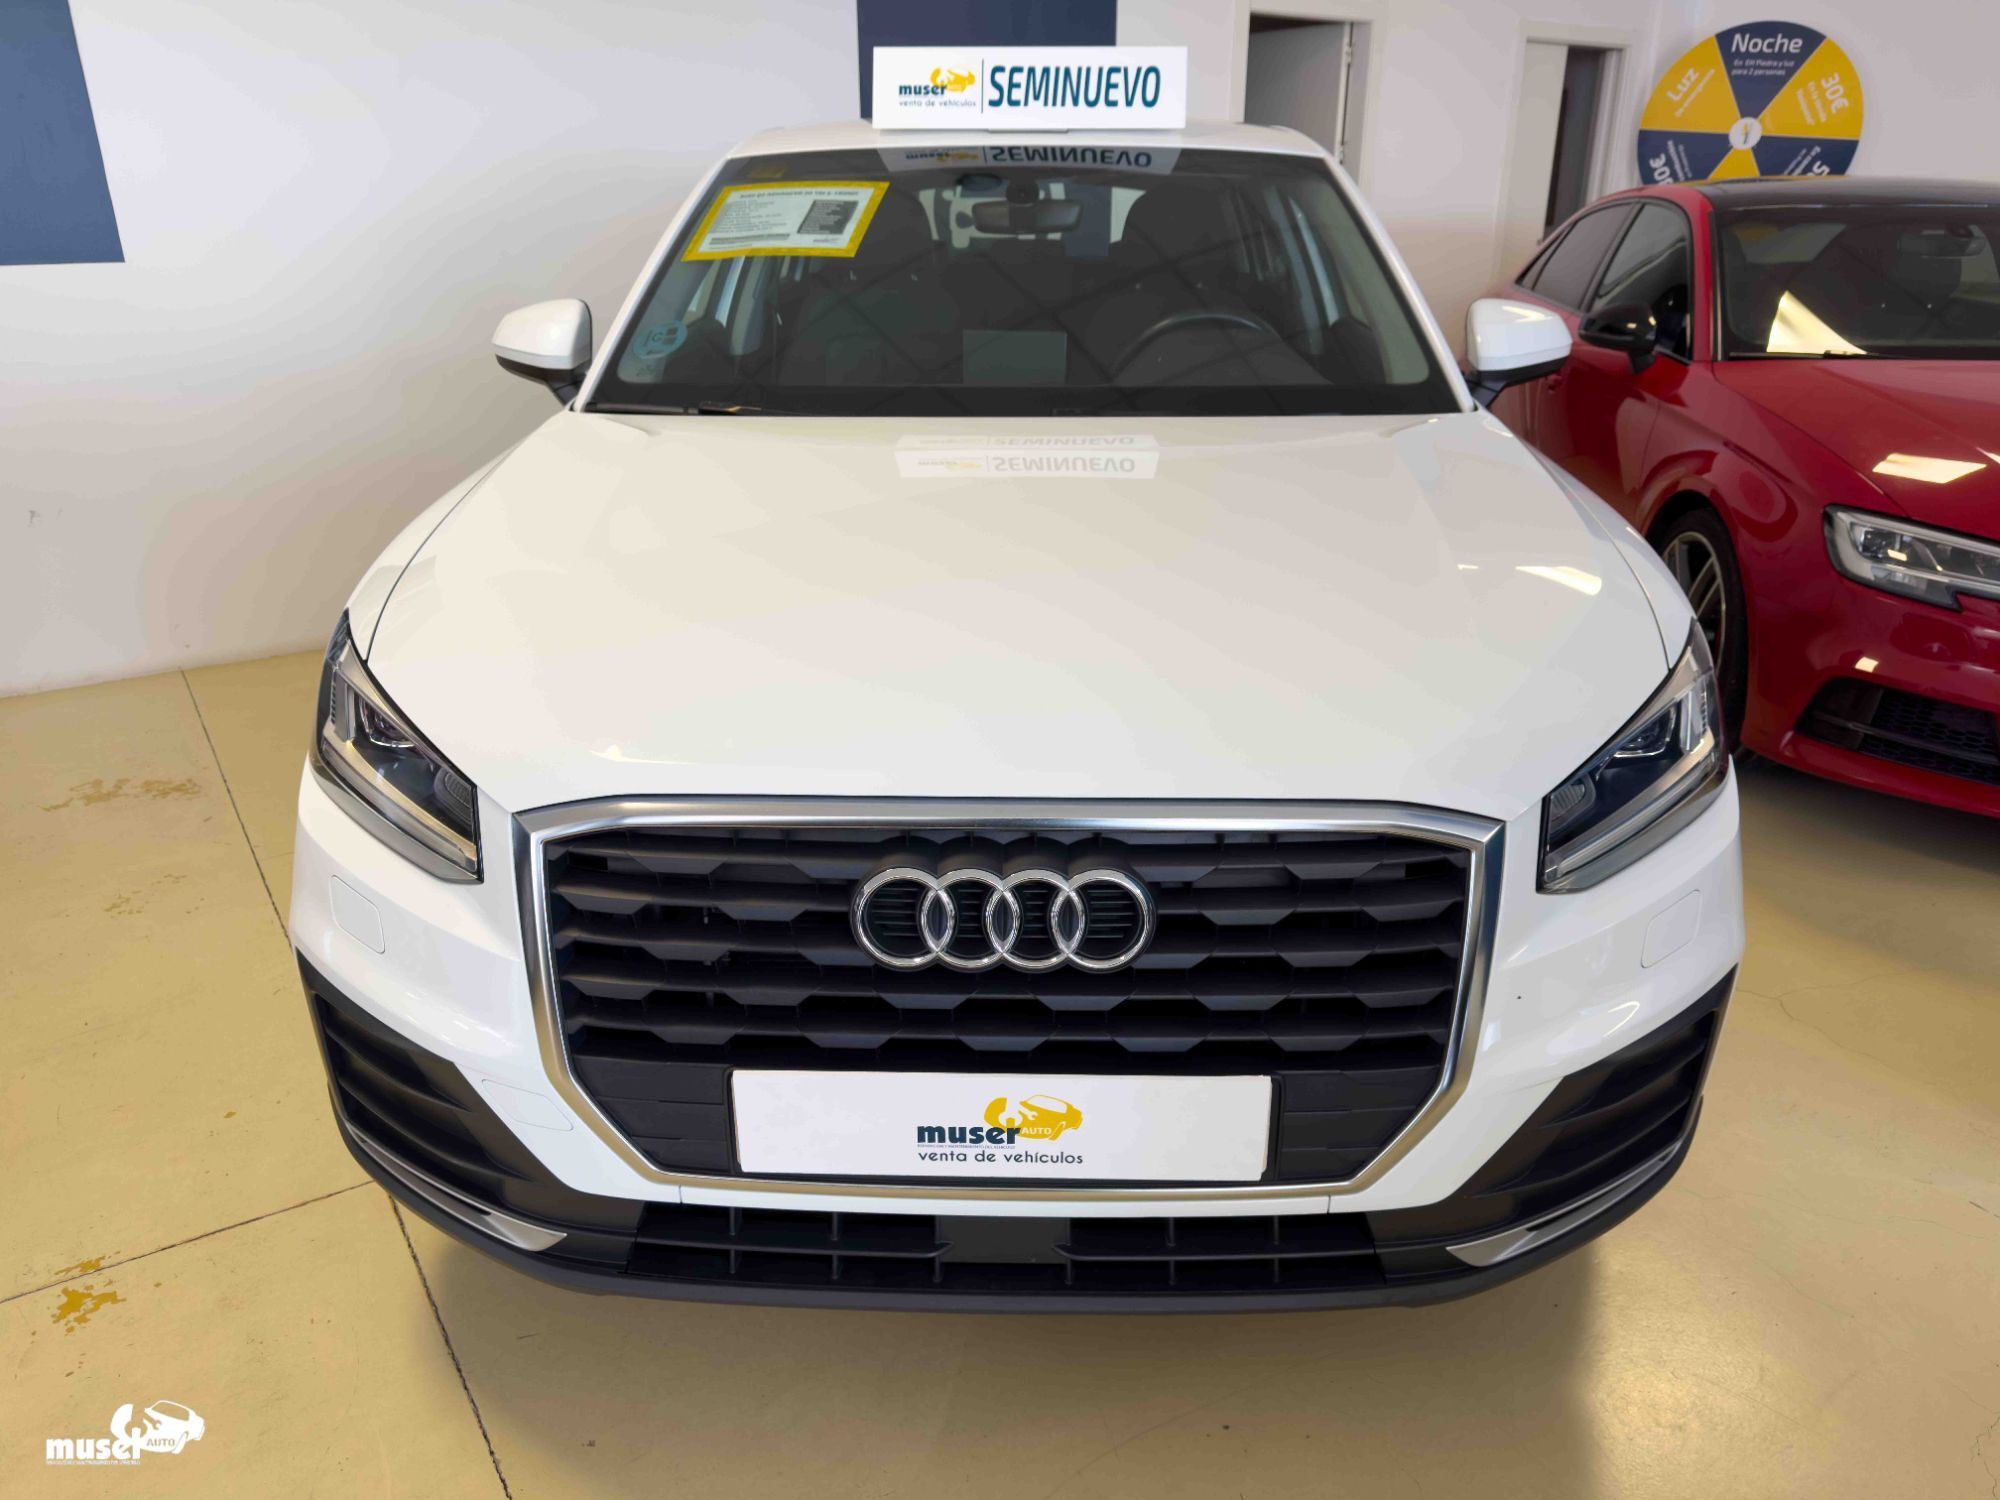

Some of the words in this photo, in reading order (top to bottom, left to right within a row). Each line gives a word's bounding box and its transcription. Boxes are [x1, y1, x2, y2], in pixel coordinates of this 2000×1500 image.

[1731, 33, 1804, 53] Noche
[899, 84, 948, 96] muser
[988, 65, 1161, 109] SEMINUEVO
[1666, 68, 1700, 101] Luz
[1821, 72, 1849, 114] 30€
[899, 98, 922, 107] venta
[925, 98, 935, 107] de
[917, 1125, 1021, 1145] muser
[1021, 1127, 1052, 1136] AUTO
[918, 1151, 967, 1162] venta
[974, 1150, 996, 1163] de
[1004, 1151, 1083, 1164] vehículos
